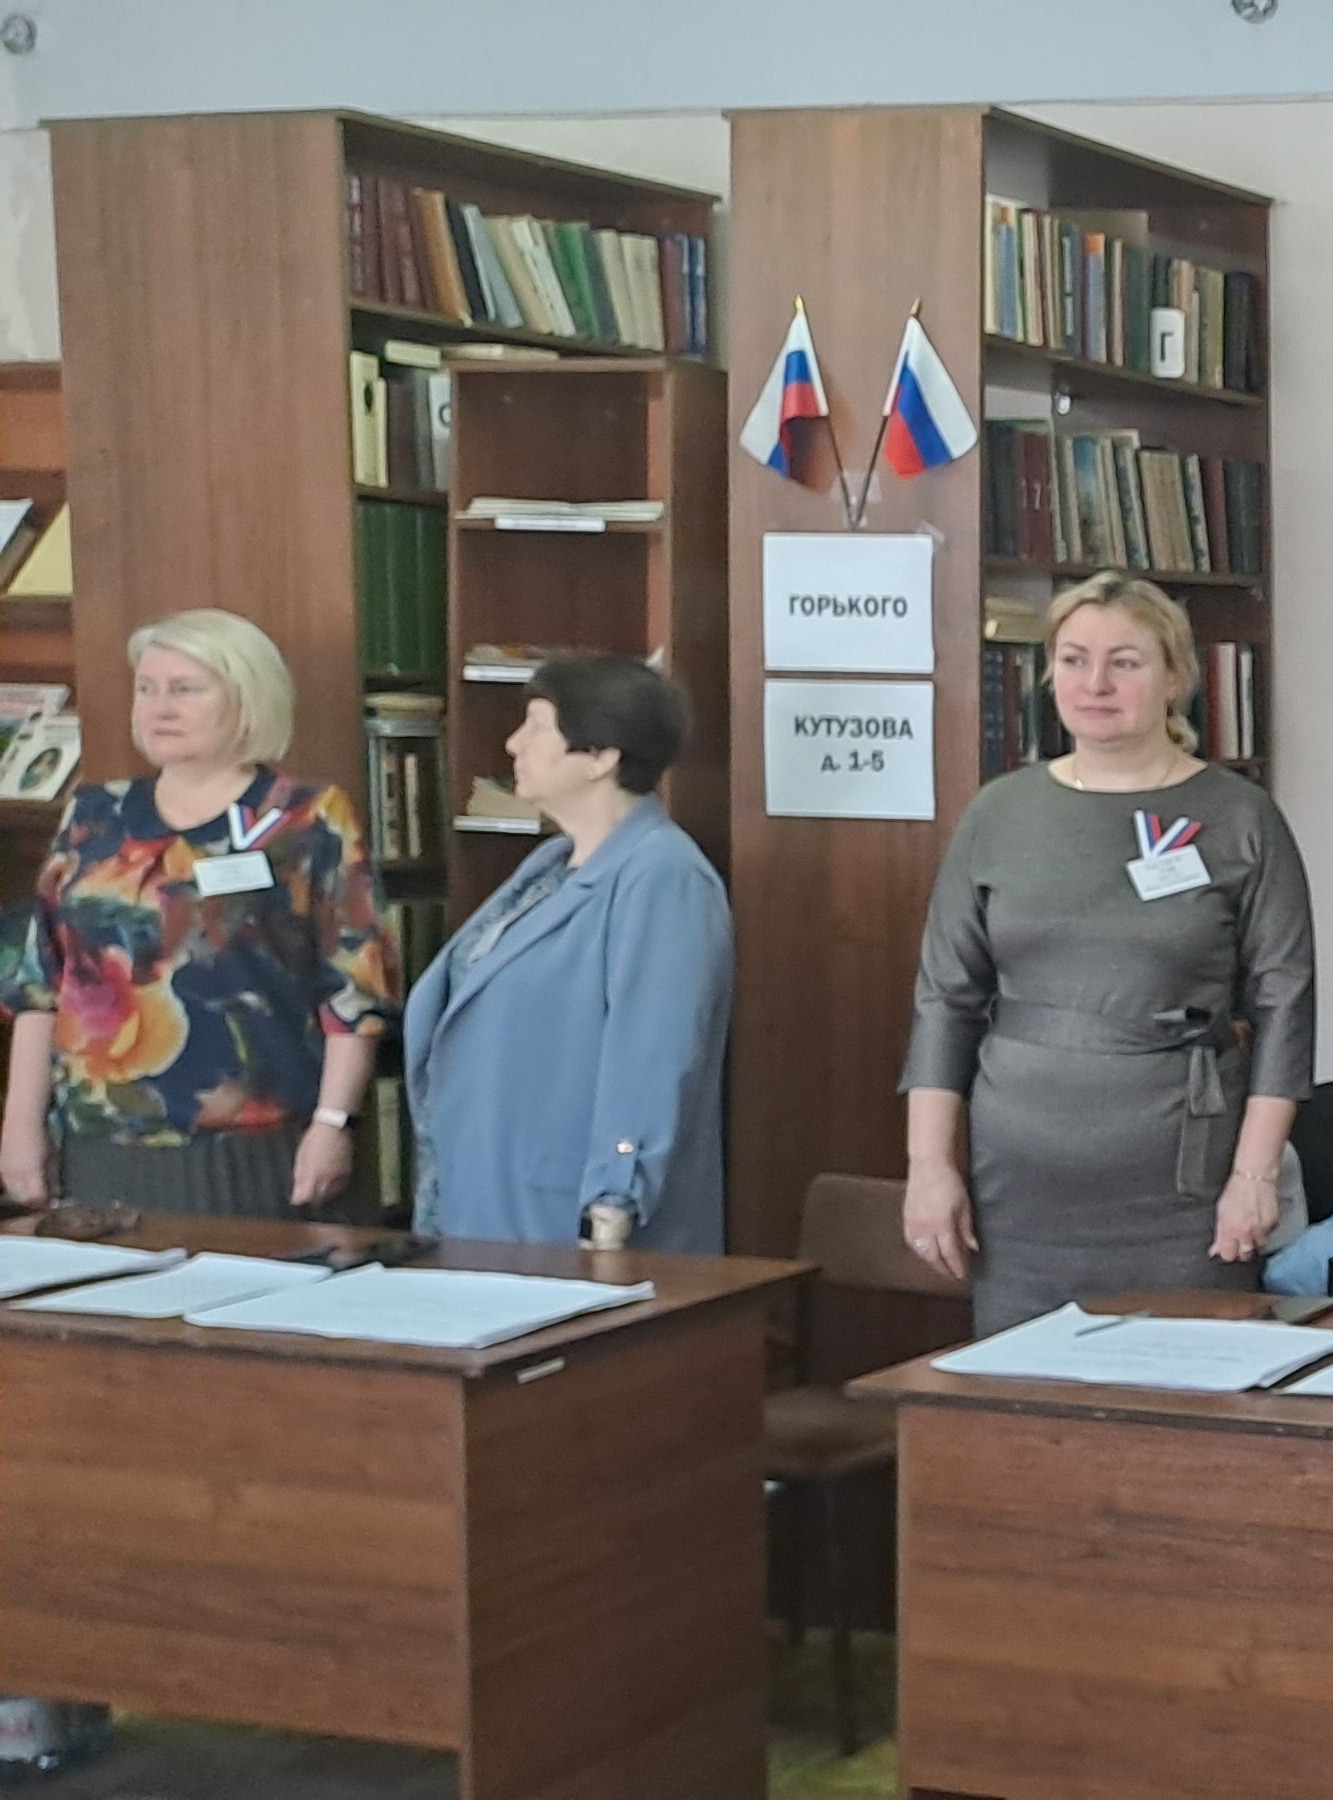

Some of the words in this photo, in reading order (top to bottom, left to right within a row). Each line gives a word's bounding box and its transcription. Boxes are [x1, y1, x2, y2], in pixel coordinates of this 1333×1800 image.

[1160, 331, 1175, 363] Г
[789, 595, 908, 618] ГОРЬКОГО
[794, 715, 913, 739] КУТУЗОВА
[820, 754, 841, 772] д.
[849, 750, 885, 773] 1-5
